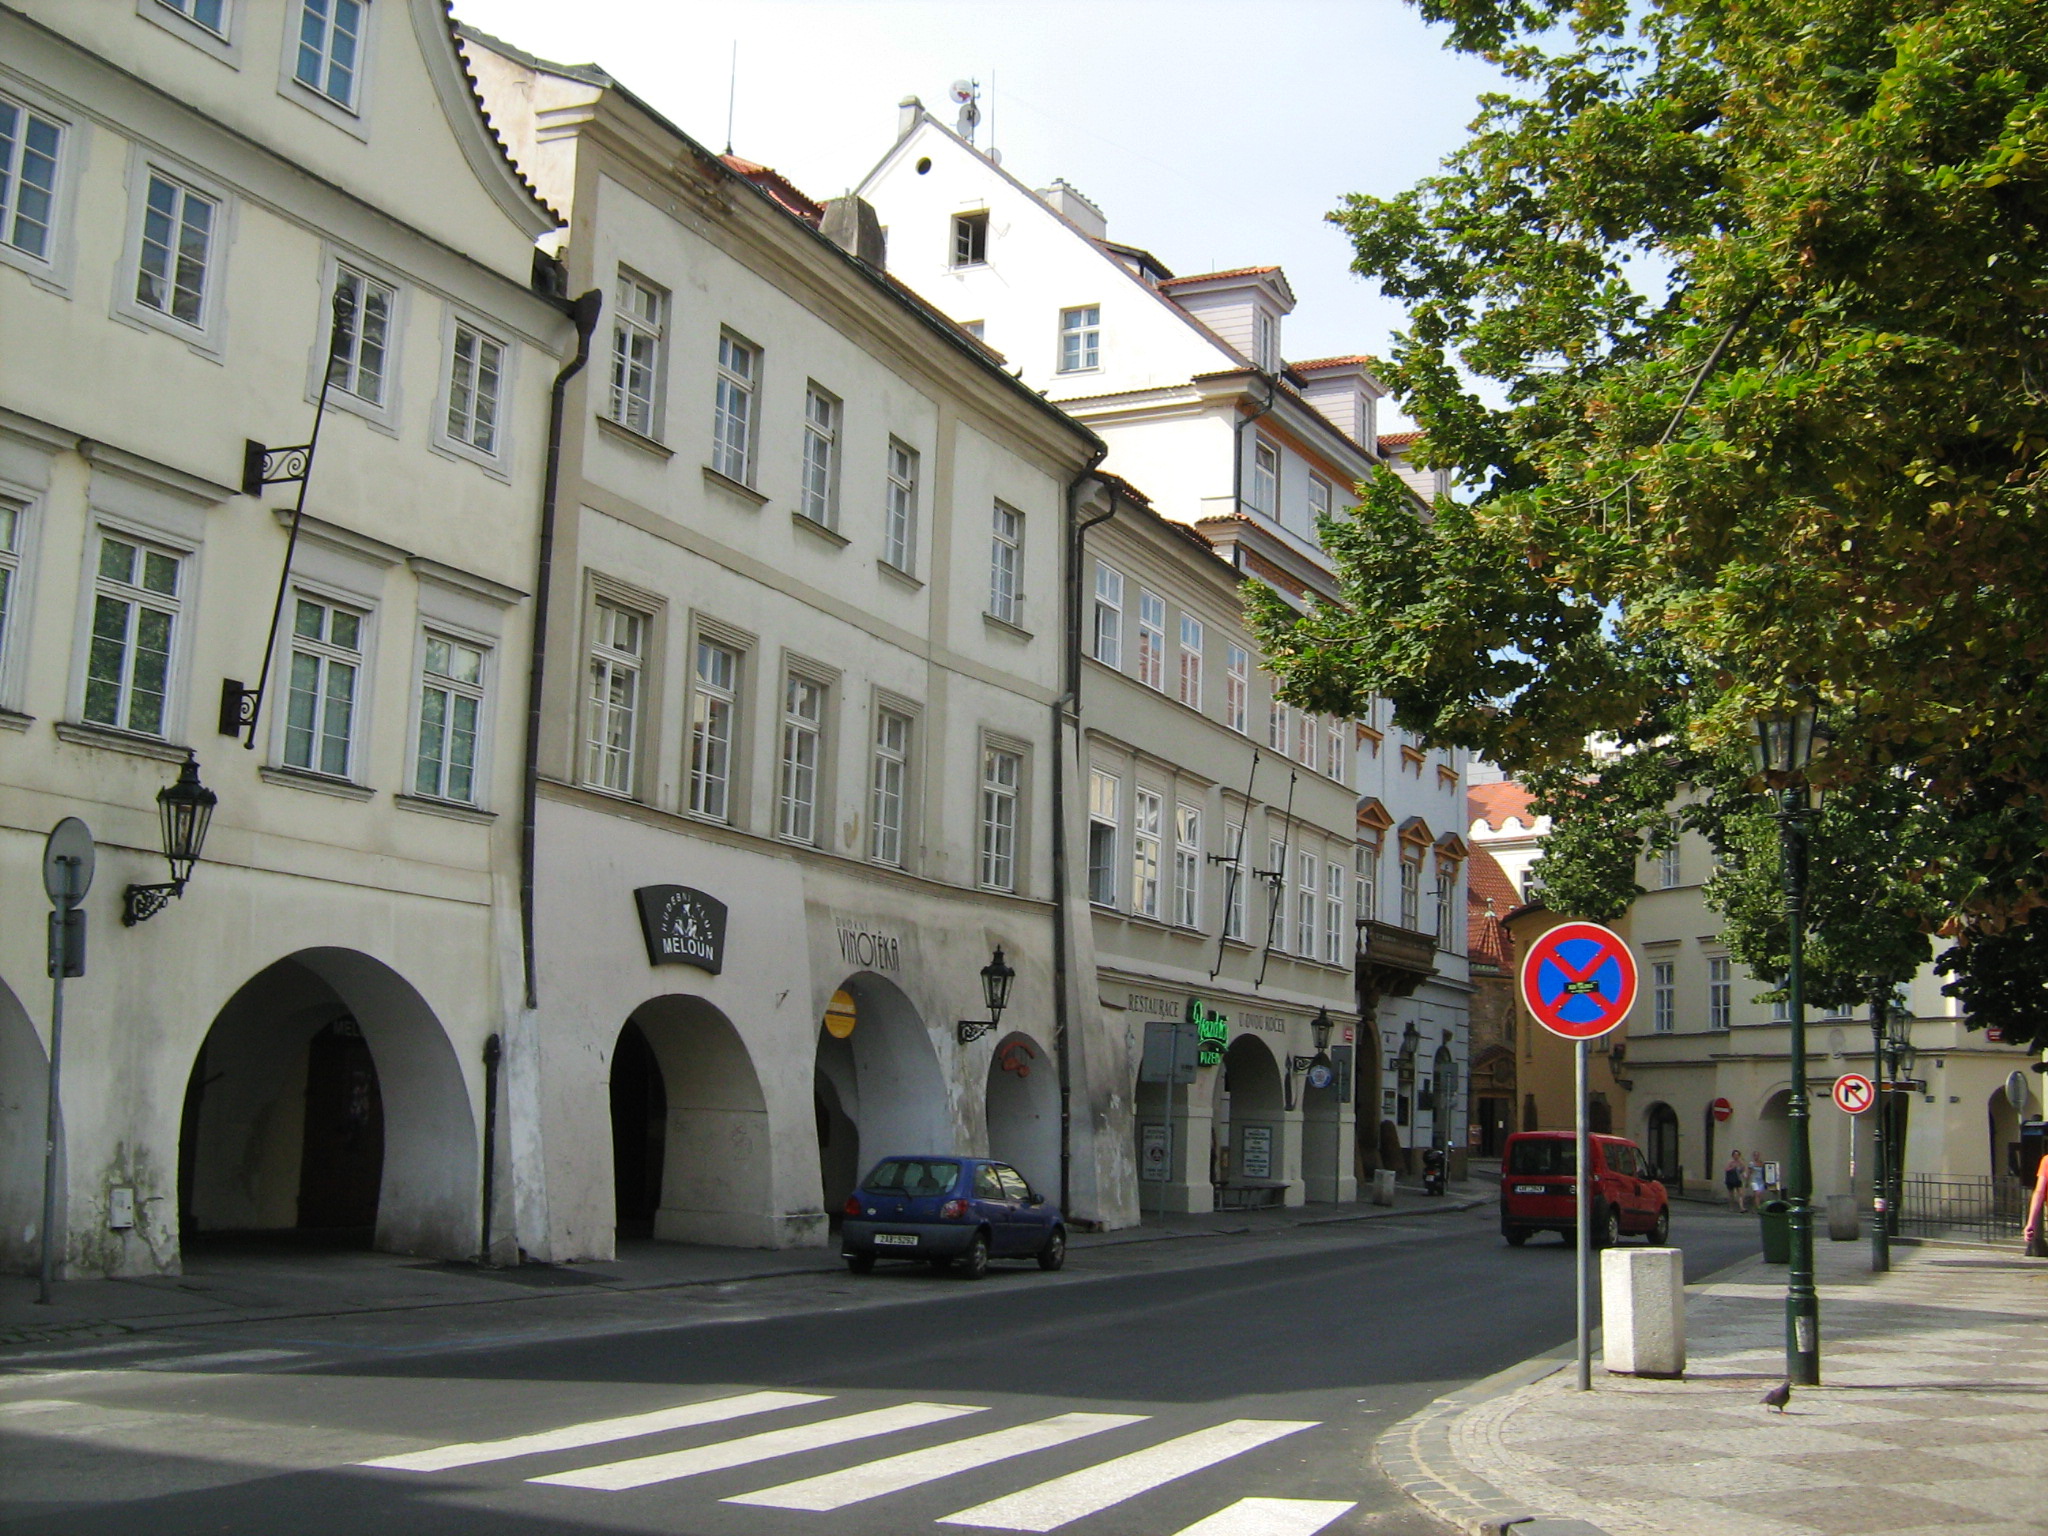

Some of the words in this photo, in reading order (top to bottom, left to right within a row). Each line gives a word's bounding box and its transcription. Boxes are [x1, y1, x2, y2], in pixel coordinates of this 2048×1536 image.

[662, 937, 714, 961] MELOUN
[837, 927, 900, 972] VINOTÉKA
[1128, 993, 1180, 1018] RESTAURACE
